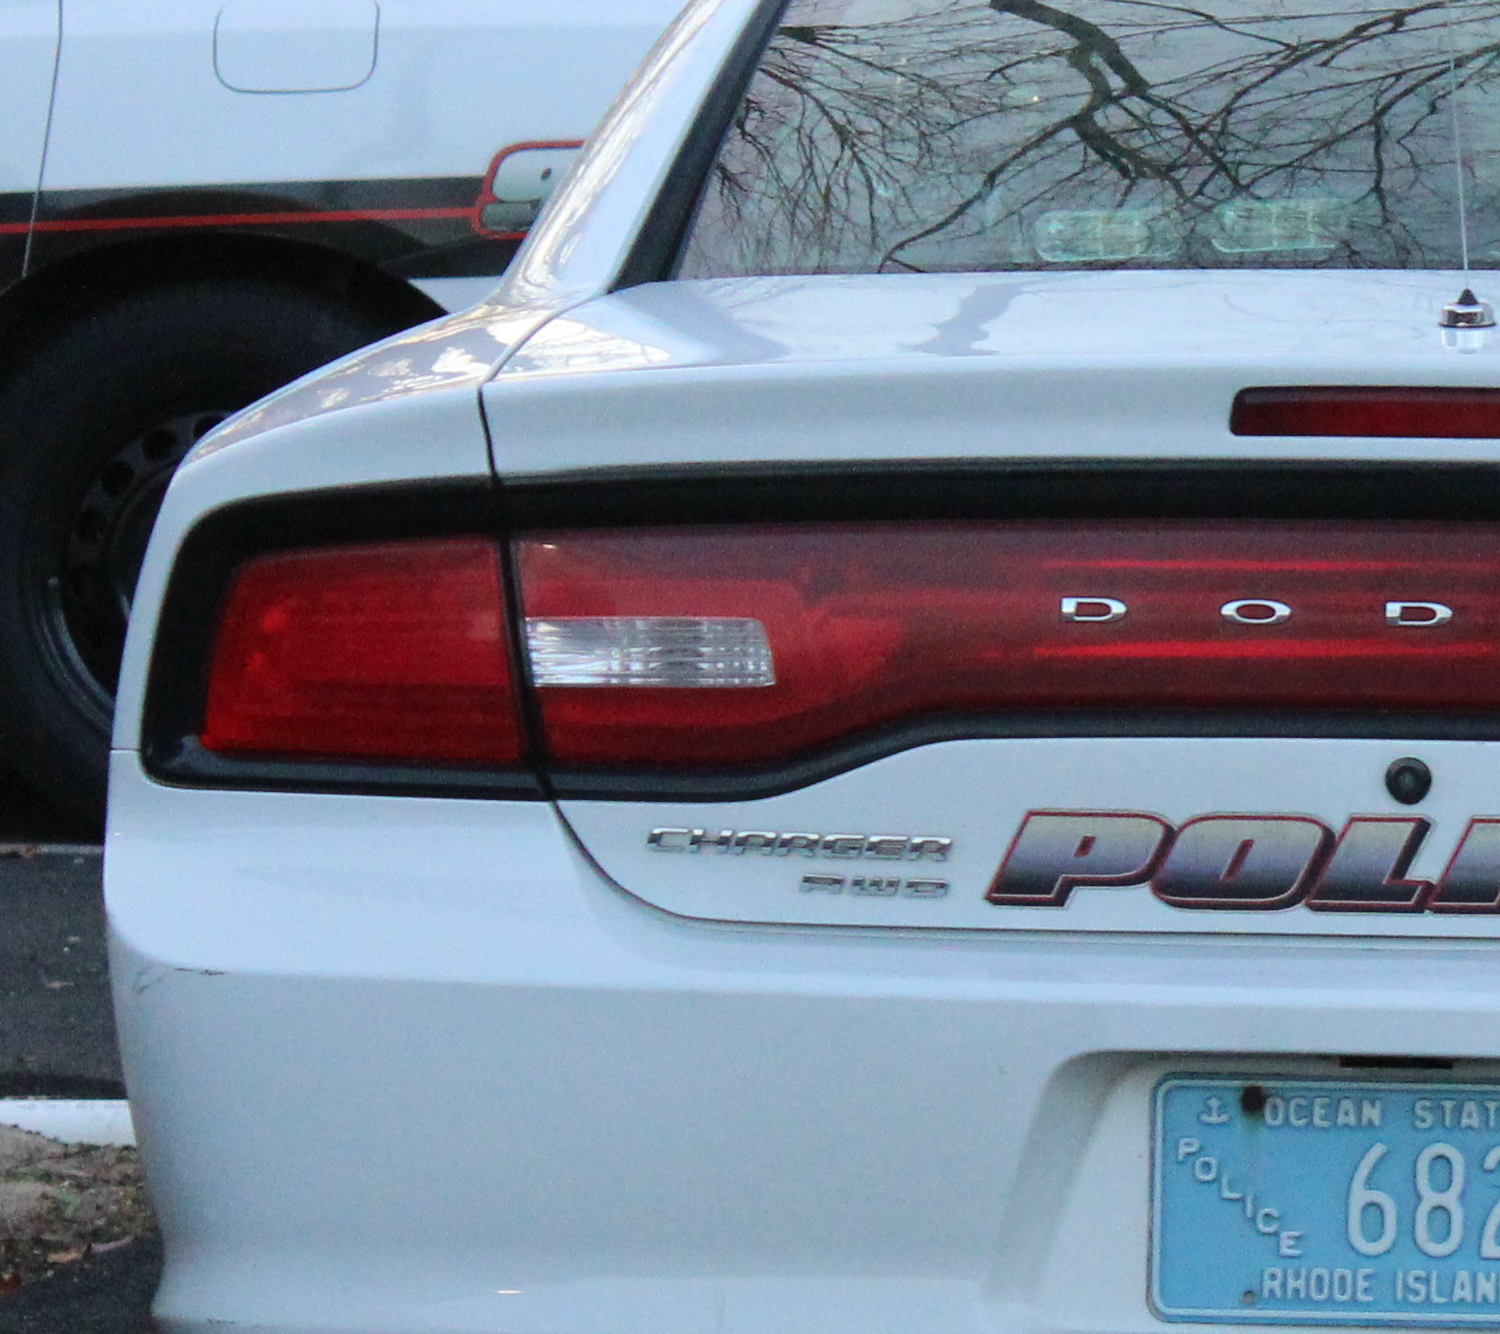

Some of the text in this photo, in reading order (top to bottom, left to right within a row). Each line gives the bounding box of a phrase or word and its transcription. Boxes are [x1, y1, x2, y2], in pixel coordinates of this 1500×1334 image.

[647, 827, 952, 862] CHARGER
[800, 873, 950, 898] AWD
[1262, 1096, 1383, 1128] OCEAN
[1177, 1137, 1303, 1258] POLICE
[1262, 1267, 1374, 1302] RHODE
